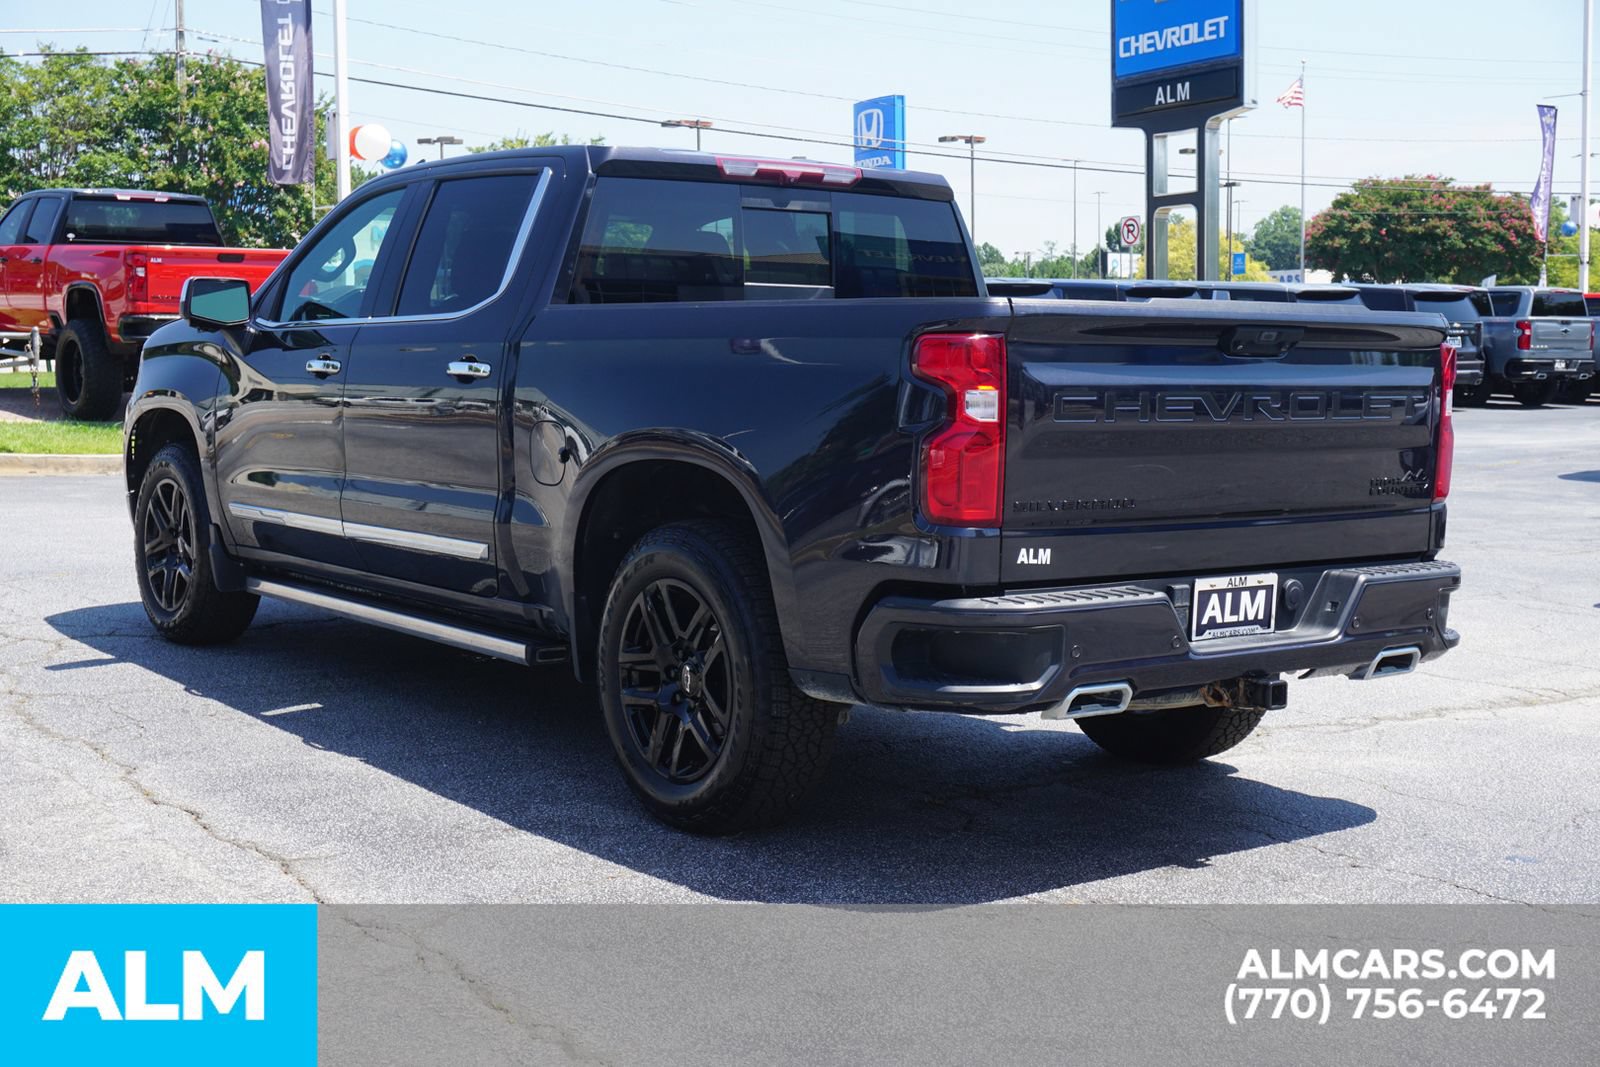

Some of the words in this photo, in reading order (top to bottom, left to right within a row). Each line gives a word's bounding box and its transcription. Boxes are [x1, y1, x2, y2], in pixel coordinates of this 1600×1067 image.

[1119, 15, 1229, 58] CHEVROLET
[1155, 81, 1190, 106] ALM
[1052, 391, 1425, 423] CHEVROLET
[1016, 548, 1052, 565] ALM
[1227, 576, 1248, 588] ALM
[1201, 589, 1266, 625] ALM
